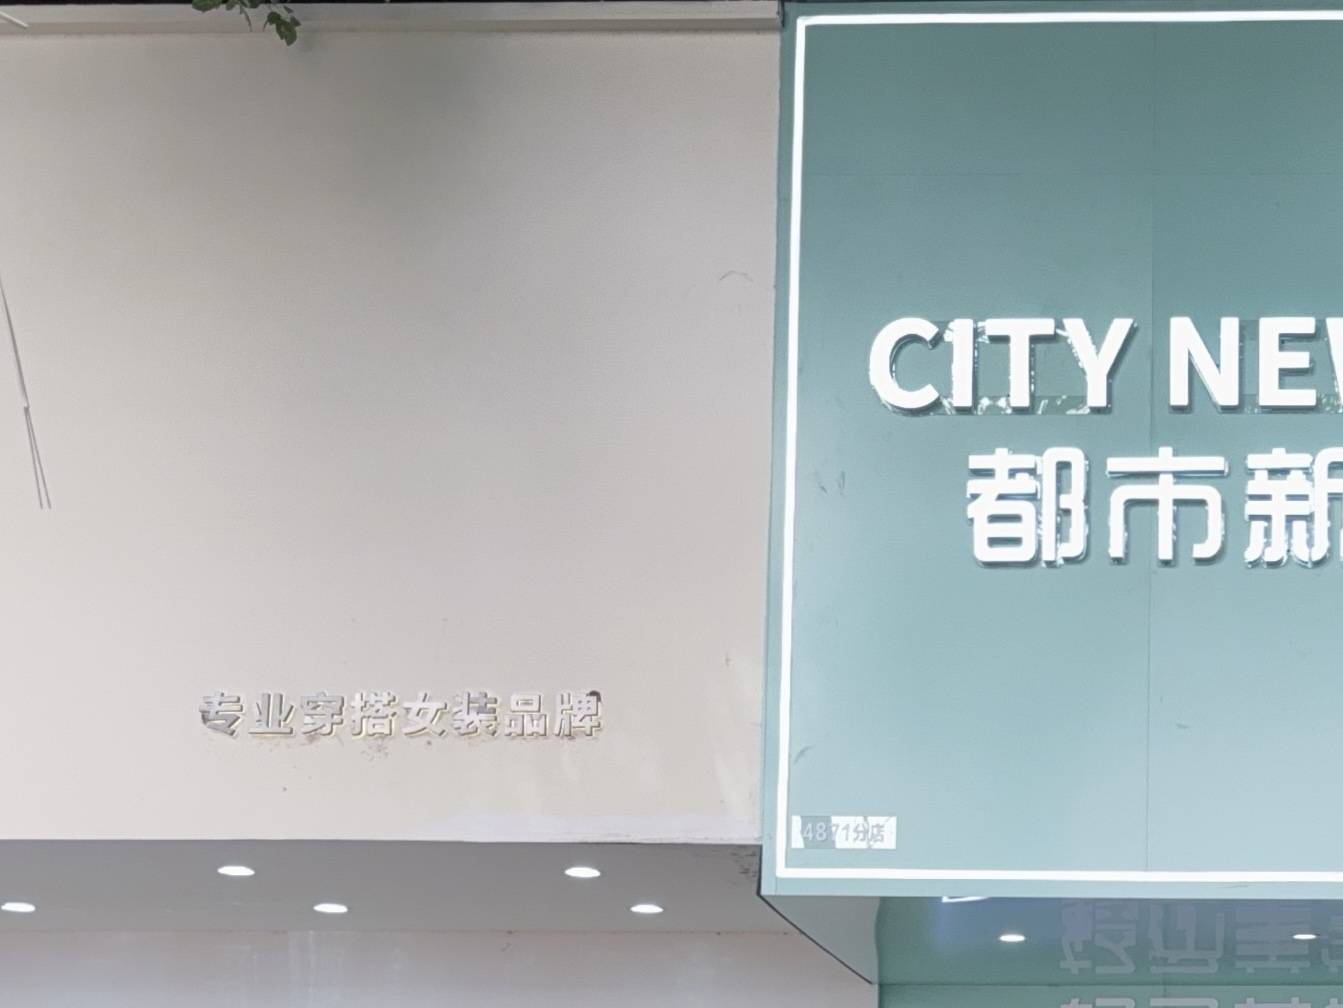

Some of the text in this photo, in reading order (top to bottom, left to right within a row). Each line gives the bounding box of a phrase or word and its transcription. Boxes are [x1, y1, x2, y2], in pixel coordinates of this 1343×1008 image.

[868, 314, 1137, 413] CITY
[199, 690, 602, 738] 专业穿搭女装品牌
